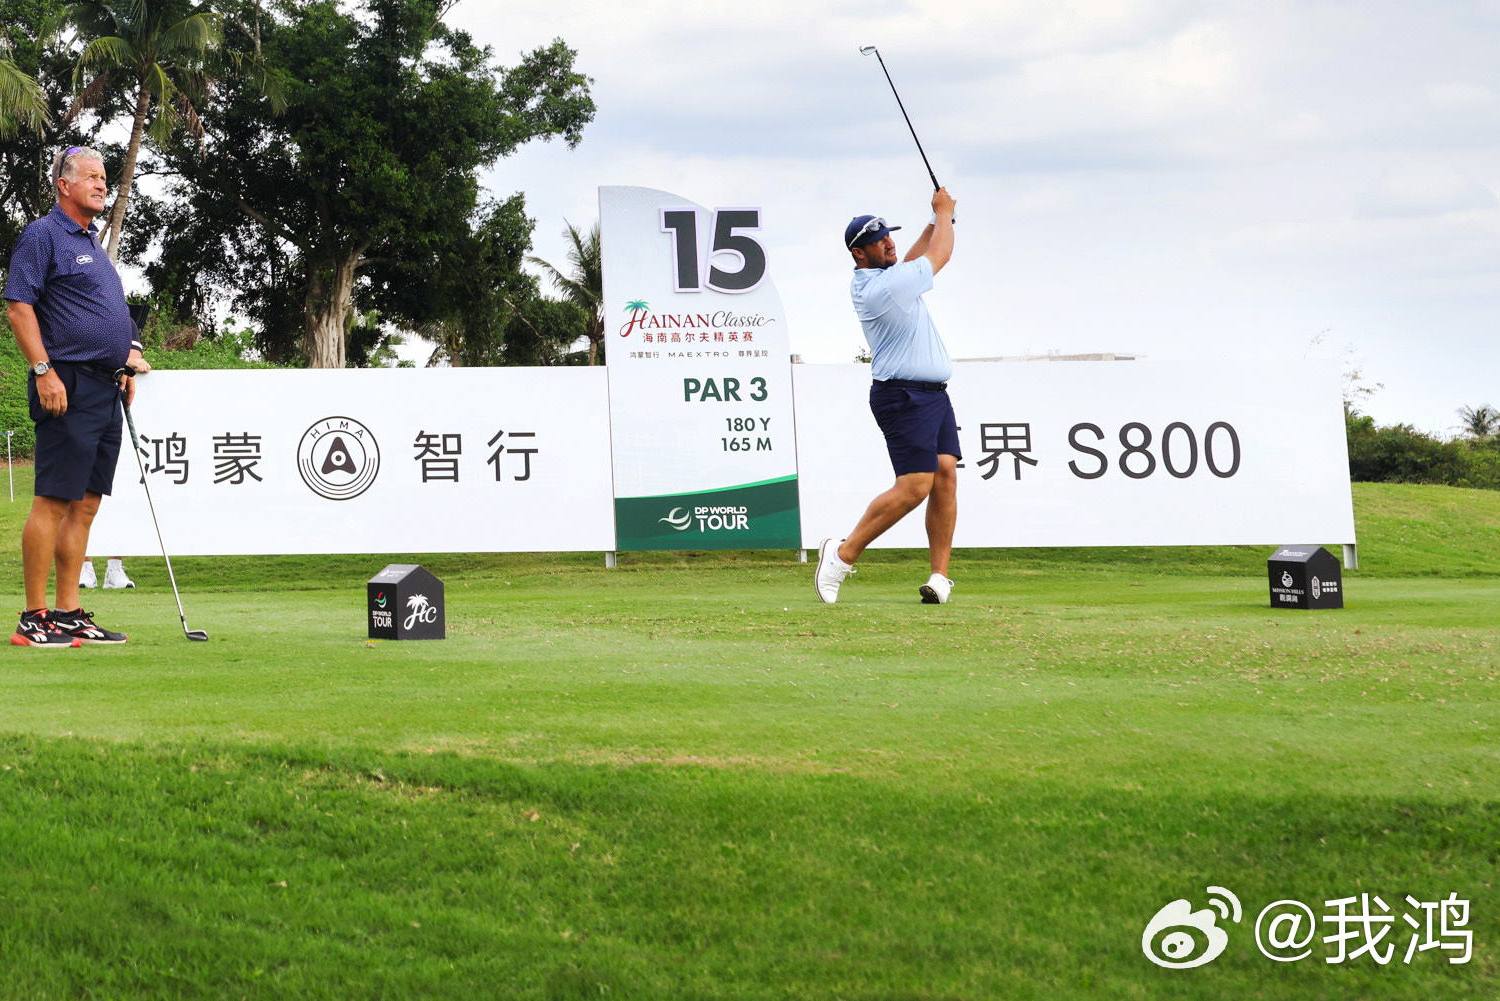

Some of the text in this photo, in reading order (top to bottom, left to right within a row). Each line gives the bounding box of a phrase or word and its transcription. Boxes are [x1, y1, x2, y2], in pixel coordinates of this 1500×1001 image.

[661, 207, 768, 293] 15
[619, 308, 776, 338] HAINAN Classic
[642, 331, 754, 344] 海南高尔夫精英赛
[629, 351, 660, 359] 鸿蒙智行
[738, 350, 769, 358] 尊界呈现
[683, 376, 768, 402] PAR 3
[310, 420, 364, 439] HIMA
[725, 417, 771, 432] 180 Y
[721, 437, 772, 452] 165 M
[956, 421, 1241, 480] 界 S800
[138, 431, 264, 485] 鸿蒙
[412, 429, 539, 484] 智行
[694, 506, 748, 515] DP WORLD
[695, 514, 750, 533] TOUR
[372, 616, 393, 628] TOUR
